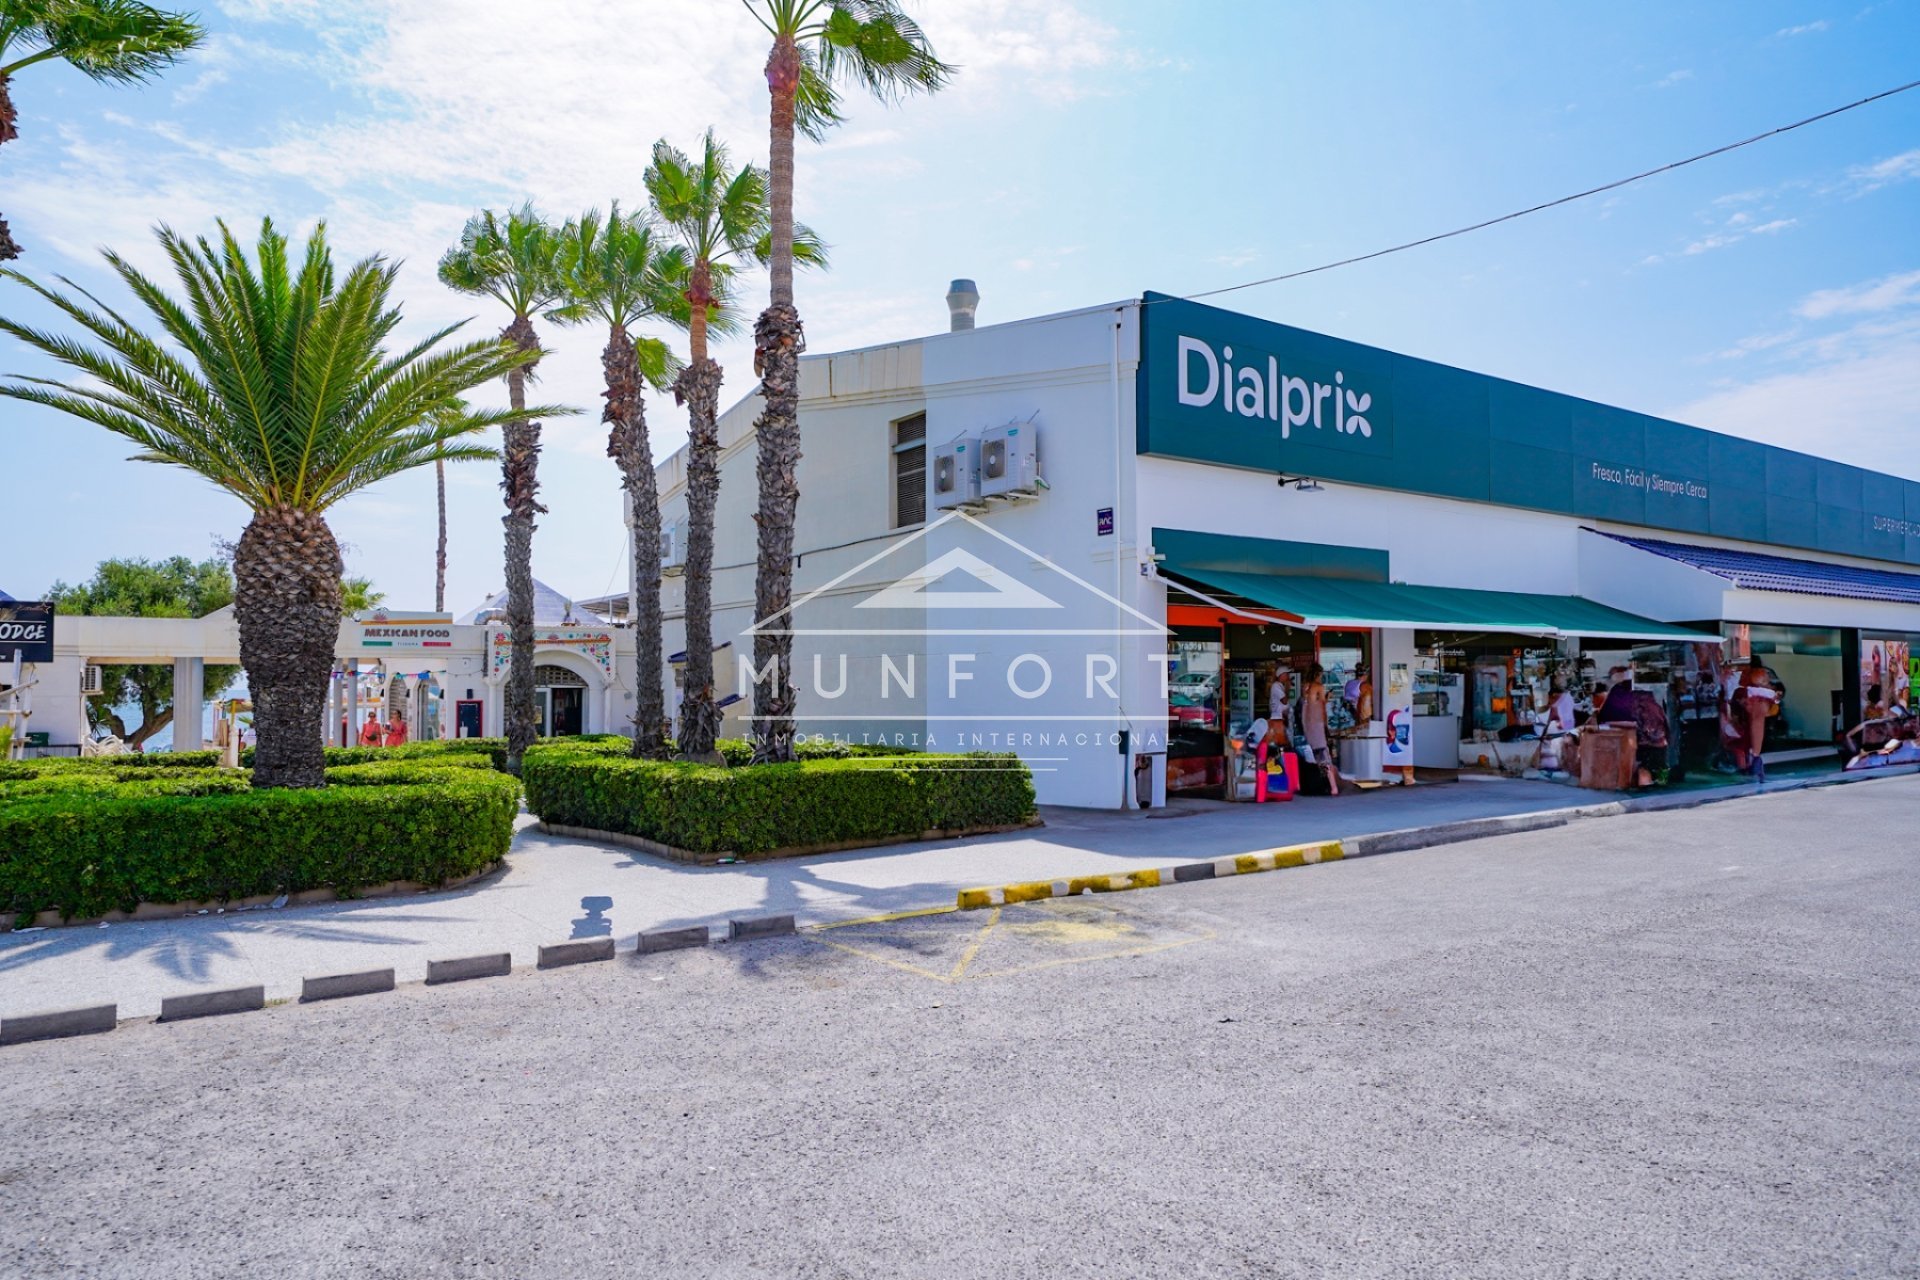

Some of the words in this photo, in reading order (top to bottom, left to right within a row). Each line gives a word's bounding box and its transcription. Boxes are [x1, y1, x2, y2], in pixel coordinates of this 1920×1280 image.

[1178, 335, 1372, 439] Dialprix
[1592, 462, 1623, 486] Fresco,
[1625, 468, 1644, 487] Fácil
[1645, 476, 1650, 493] y
[1651, 474, 1684, 497] Siempre
[1685, 481, 1707, 499] Cerca
[365, 628, 418, 638] MEXICAN
[420, 629, 450, 638] FOOD
[1270, 642, 1290, 653] Carne
